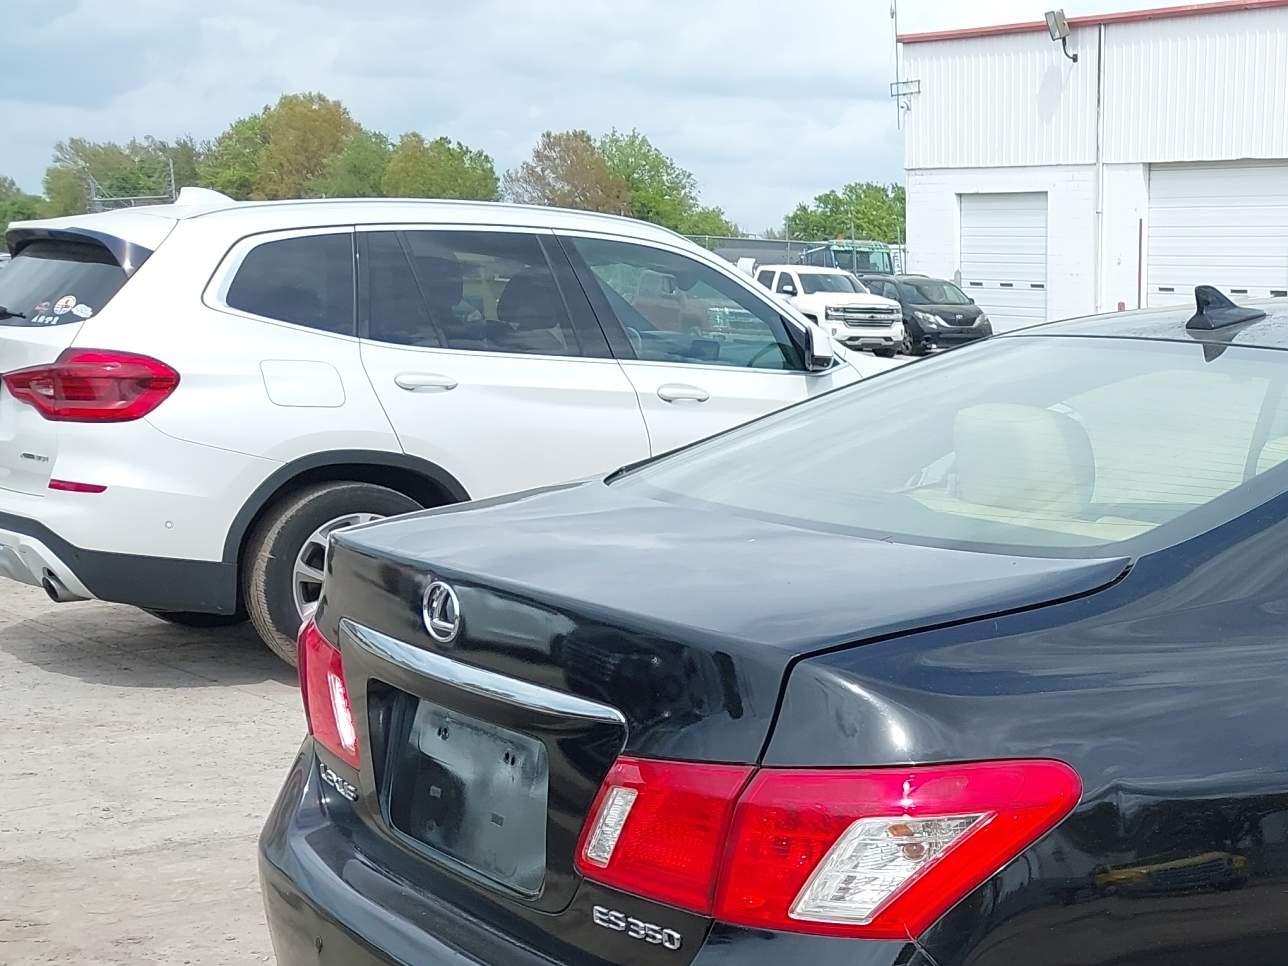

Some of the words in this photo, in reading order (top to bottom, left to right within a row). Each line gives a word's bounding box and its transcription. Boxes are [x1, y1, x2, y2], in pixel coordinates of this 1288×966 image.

[319, 763, 358, 801] LEXUS
[593, 905, 626, 931] ES
[627, 917, 681, 950] 350
